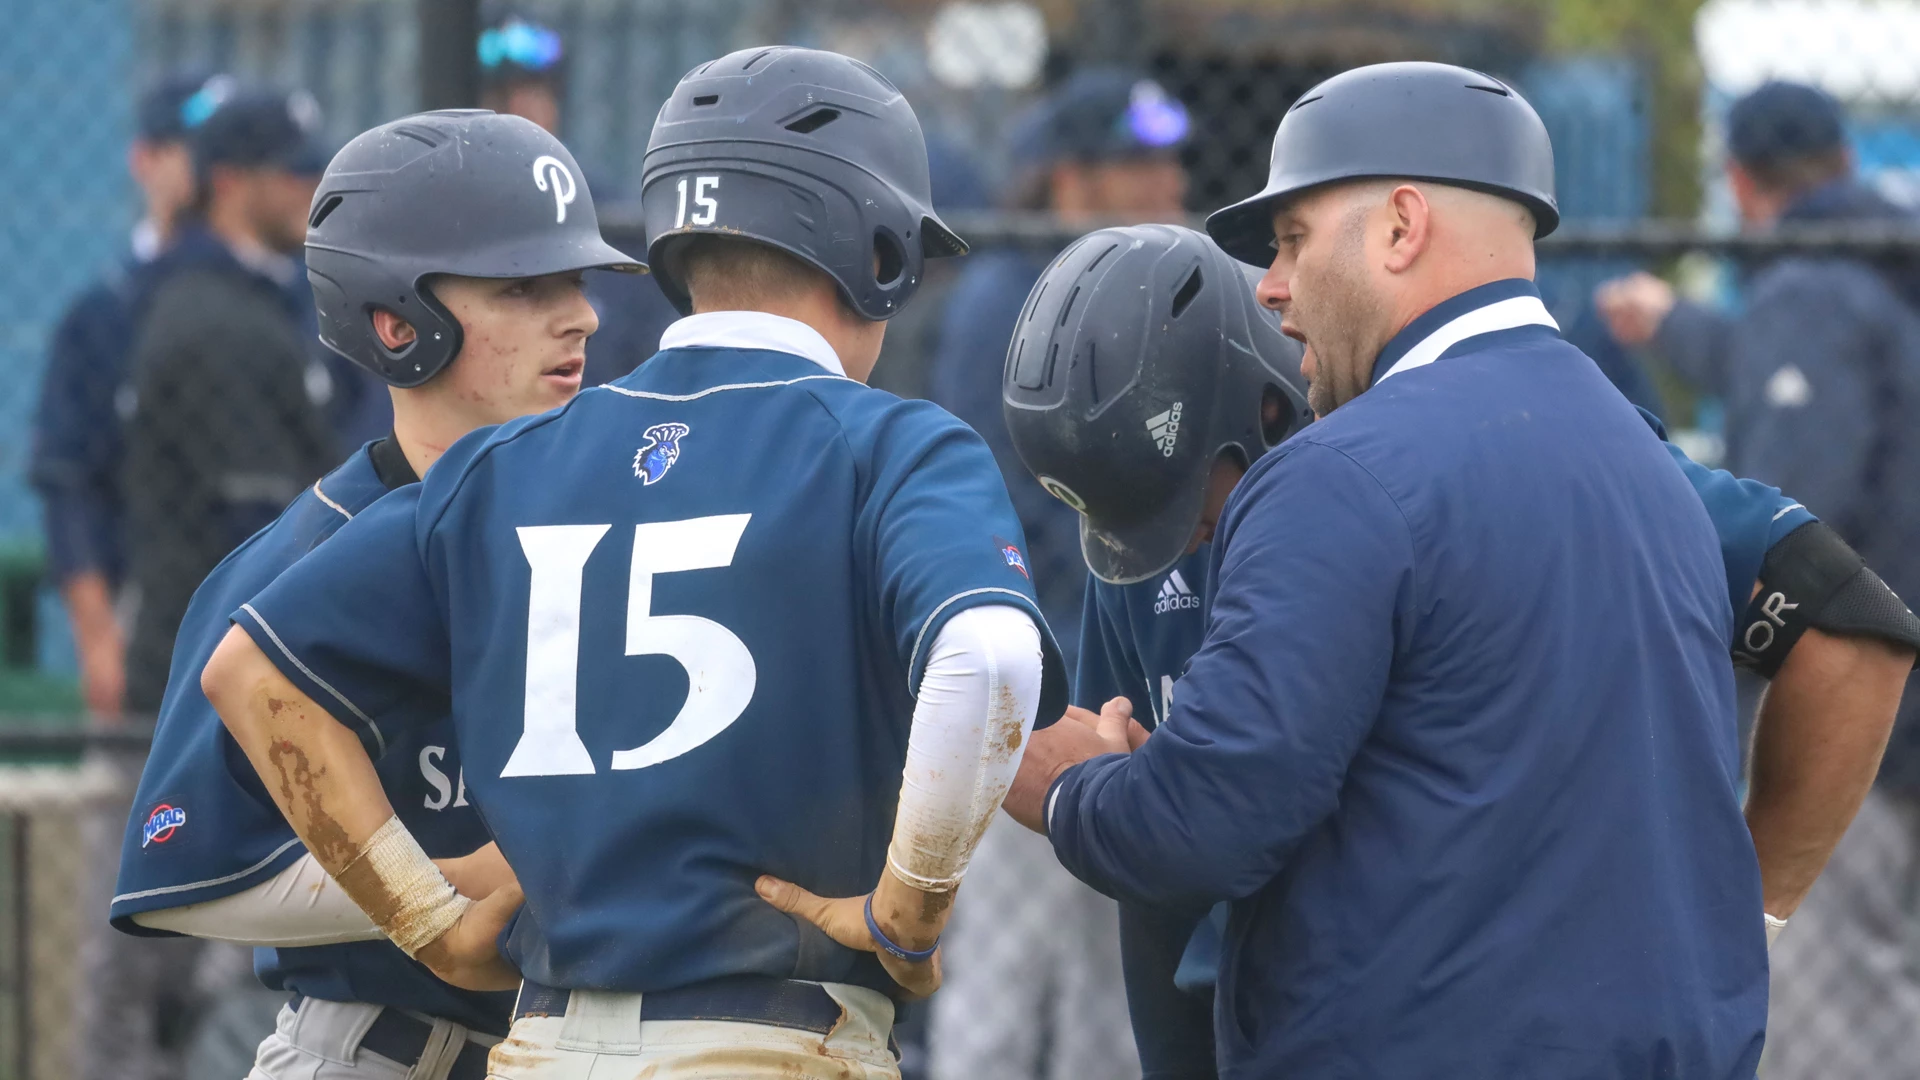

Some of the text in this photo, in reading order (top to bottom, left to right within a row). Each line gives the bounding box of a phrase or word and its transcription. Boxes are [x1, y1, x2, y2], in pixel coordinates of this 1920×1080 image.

[533, 155, 577, 225] P
[674, 176, 720, 229] 15
[1163, 401, 1183, 457] adidas
[1154, 594, 1200, 615] adidas
[499, 512, 758, 778] 15
[142, 807, 186, 848] MAAC
